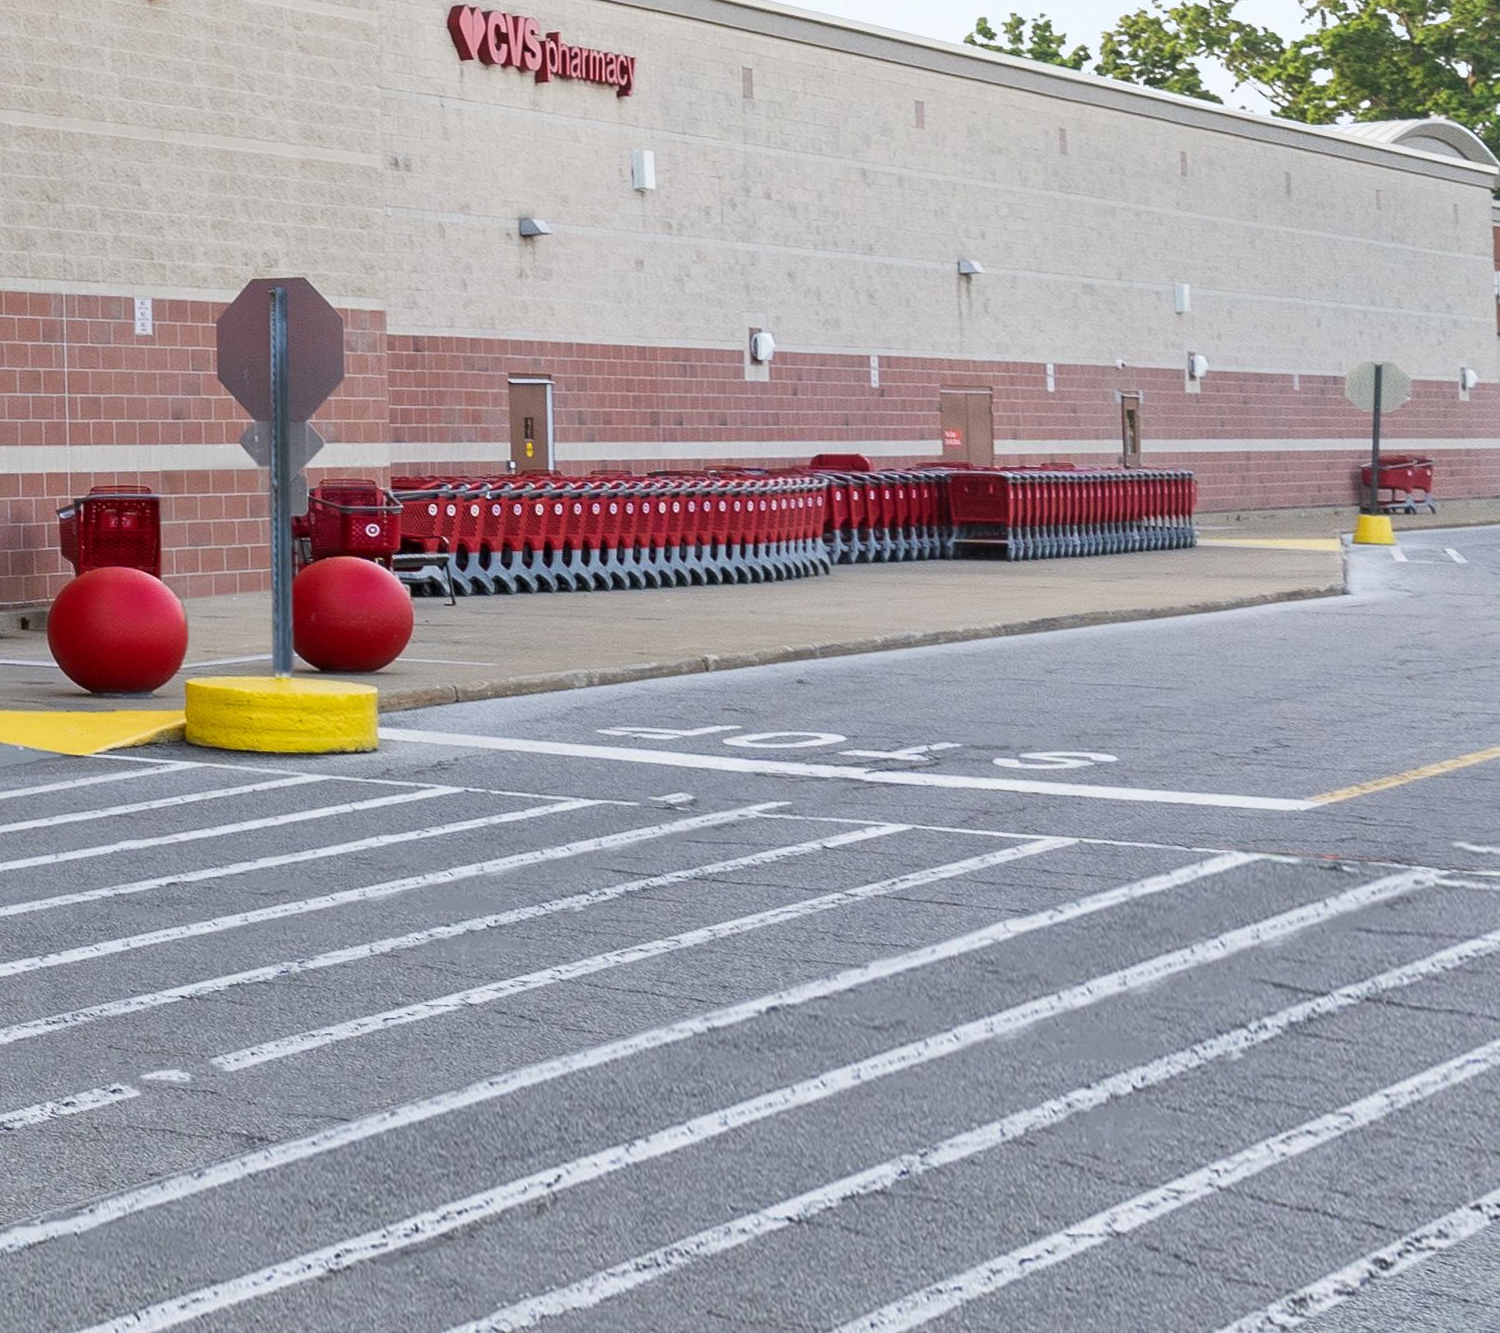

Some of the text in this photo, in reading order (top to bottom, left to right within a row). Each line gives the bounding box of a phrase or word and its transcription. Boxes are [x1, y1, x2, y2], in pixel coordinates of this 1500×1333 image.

[478, 10, 637, 98] CVS pharmacy
[596, 723, 1119, 771] STOP
